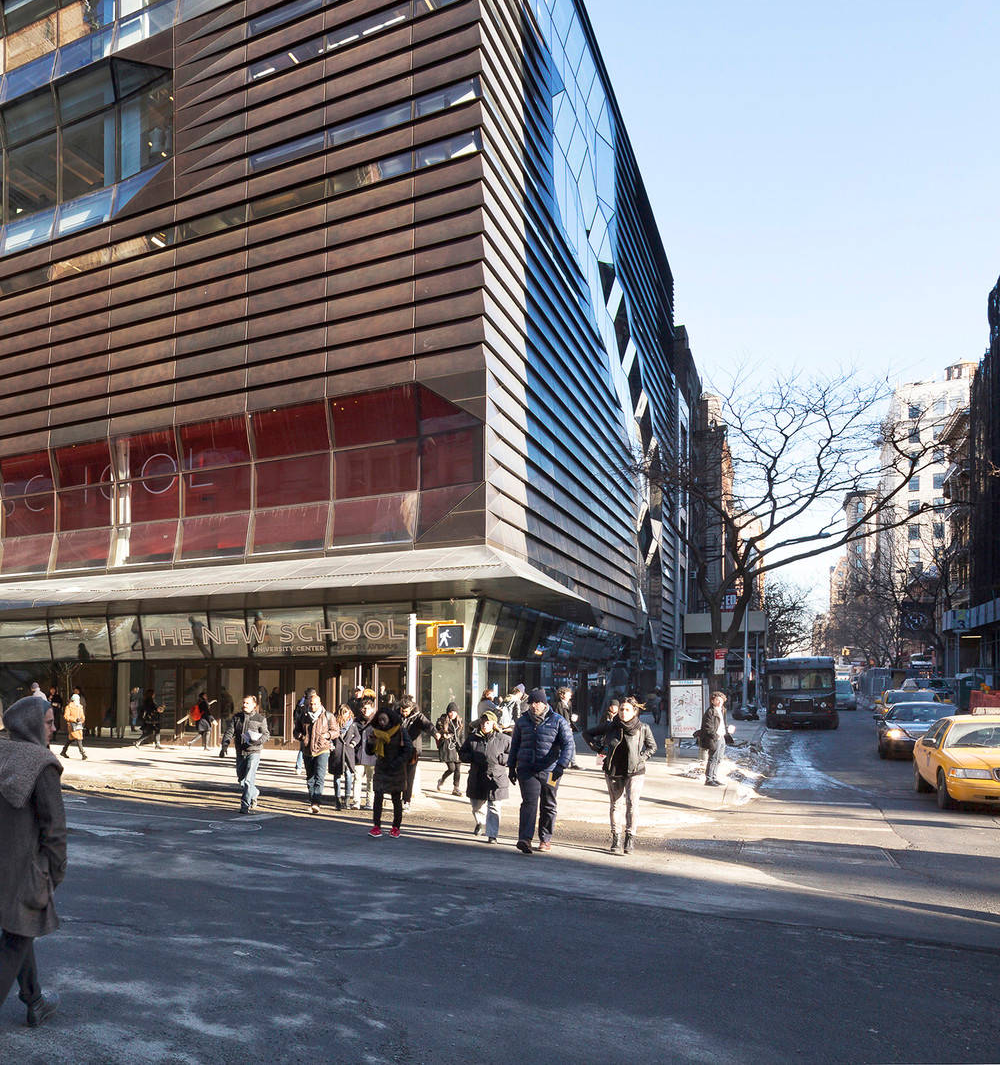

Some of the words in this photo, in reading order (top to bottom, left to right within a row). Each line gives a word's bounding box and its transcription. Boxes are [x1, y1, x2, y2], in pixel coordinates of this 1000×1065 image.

[145, 627, 194, 646] THE
[201, 624, 267, 645] NEW
[279, 619, 405, 642] SCHOOL
